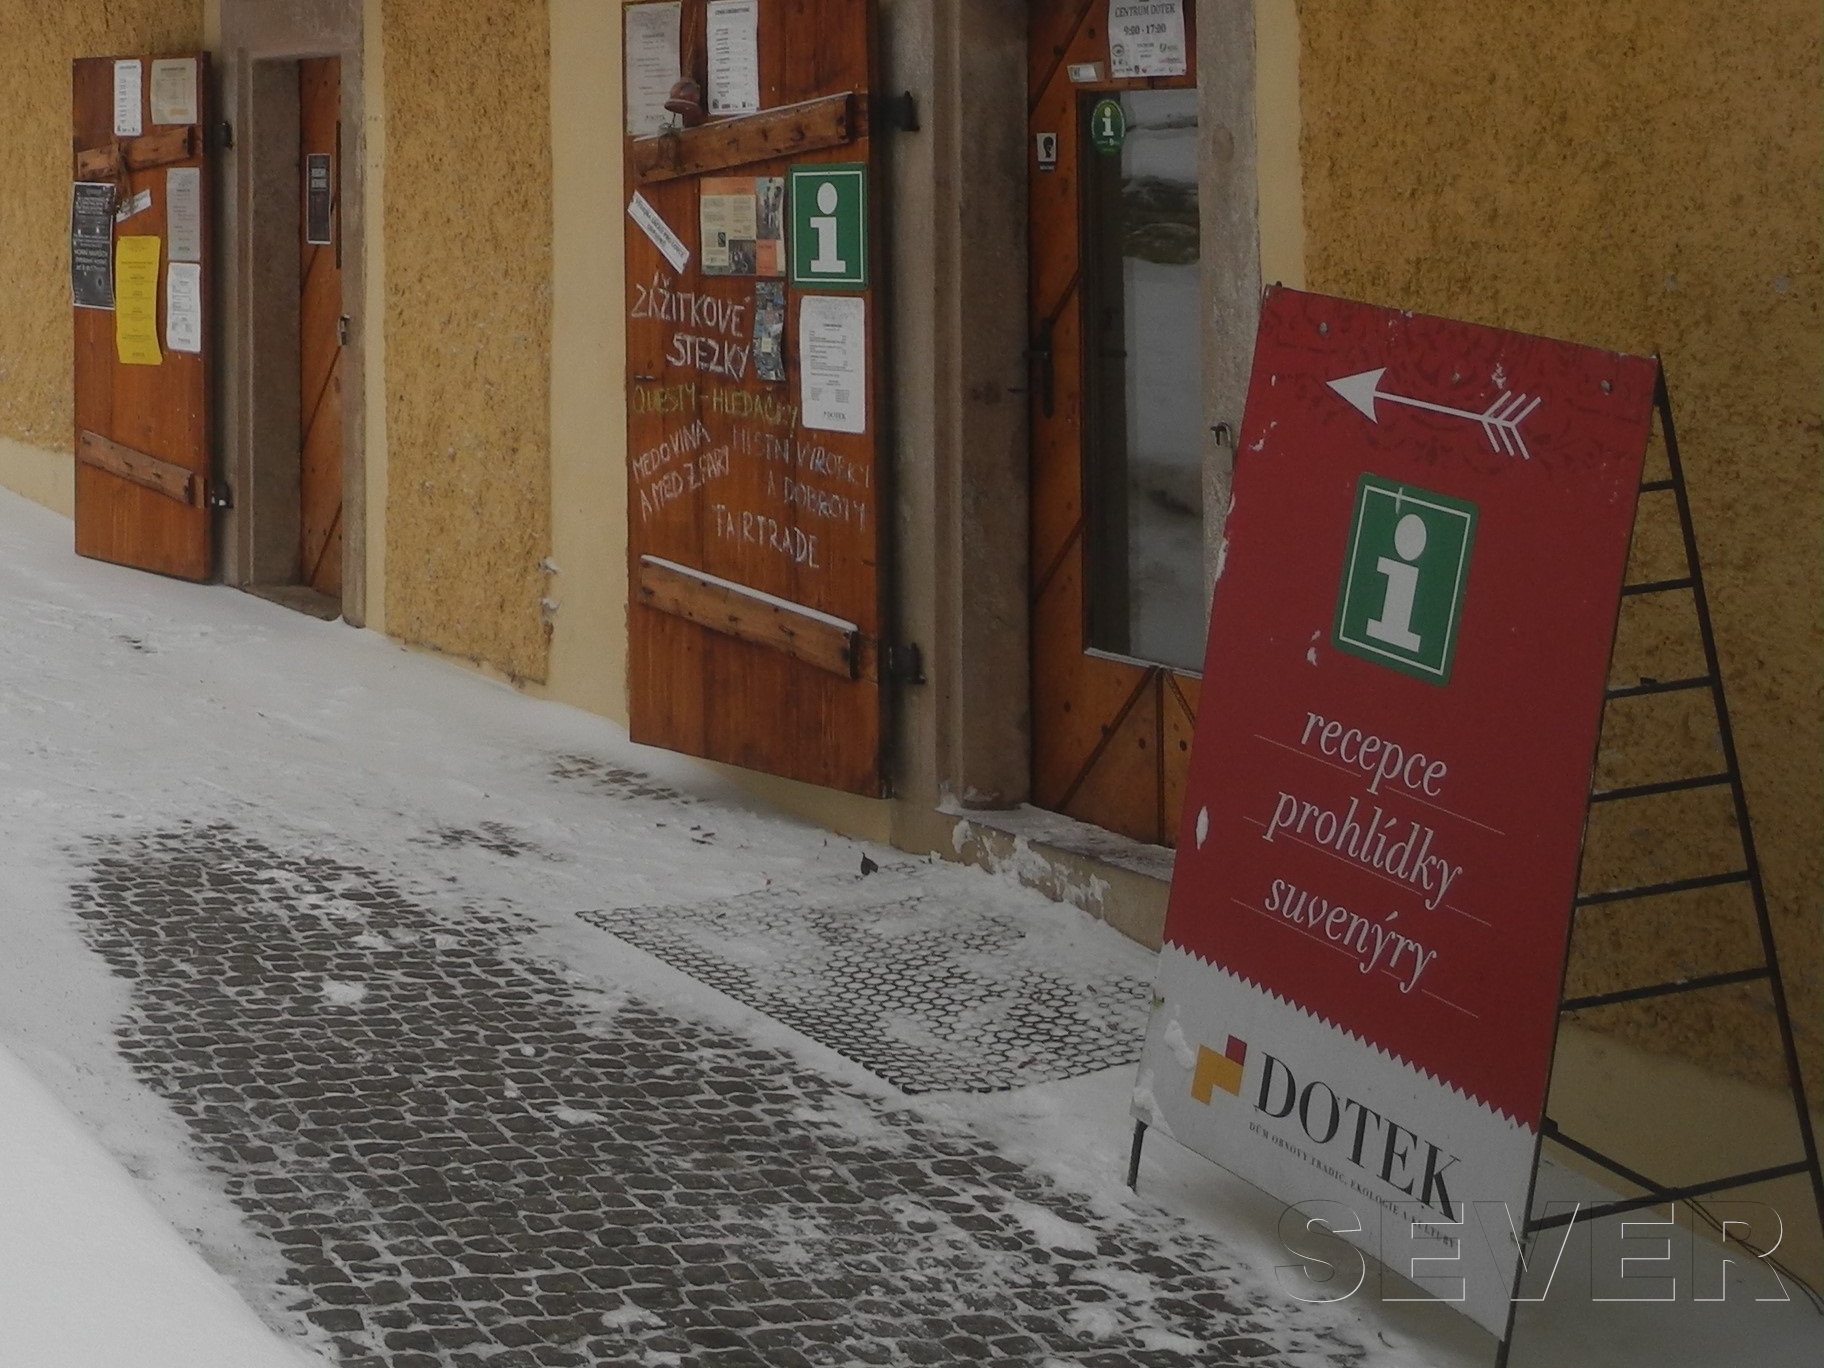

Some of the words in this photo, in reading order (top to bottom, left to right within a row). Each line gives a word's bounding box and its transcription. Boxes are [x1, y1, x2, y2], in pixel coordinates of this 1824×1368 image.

[1114, 5, 1149, 18] CENTRUM
[630, 272, 752, 338] ZÁŽITKOVÉ
[665, 332, 751, 382] STEZKY
[632, 382, 696, 415] QUESTY
[632, 418, 711, 484] MEDOVINA
[1300, 711, 1448, 797] recepce
[1262, 791, 1463, 911] prohlídky
[1263, 878, 1438, 995] suvenýry
[1252, 1050, 1462, 1224] DOTEK
[1270, 1134, 1309, 1162] OBNOVY
[1349, 1179, 1400, 1216] EKOLOGIE
[1411, 1215, 1457, 1249] KULTURY
